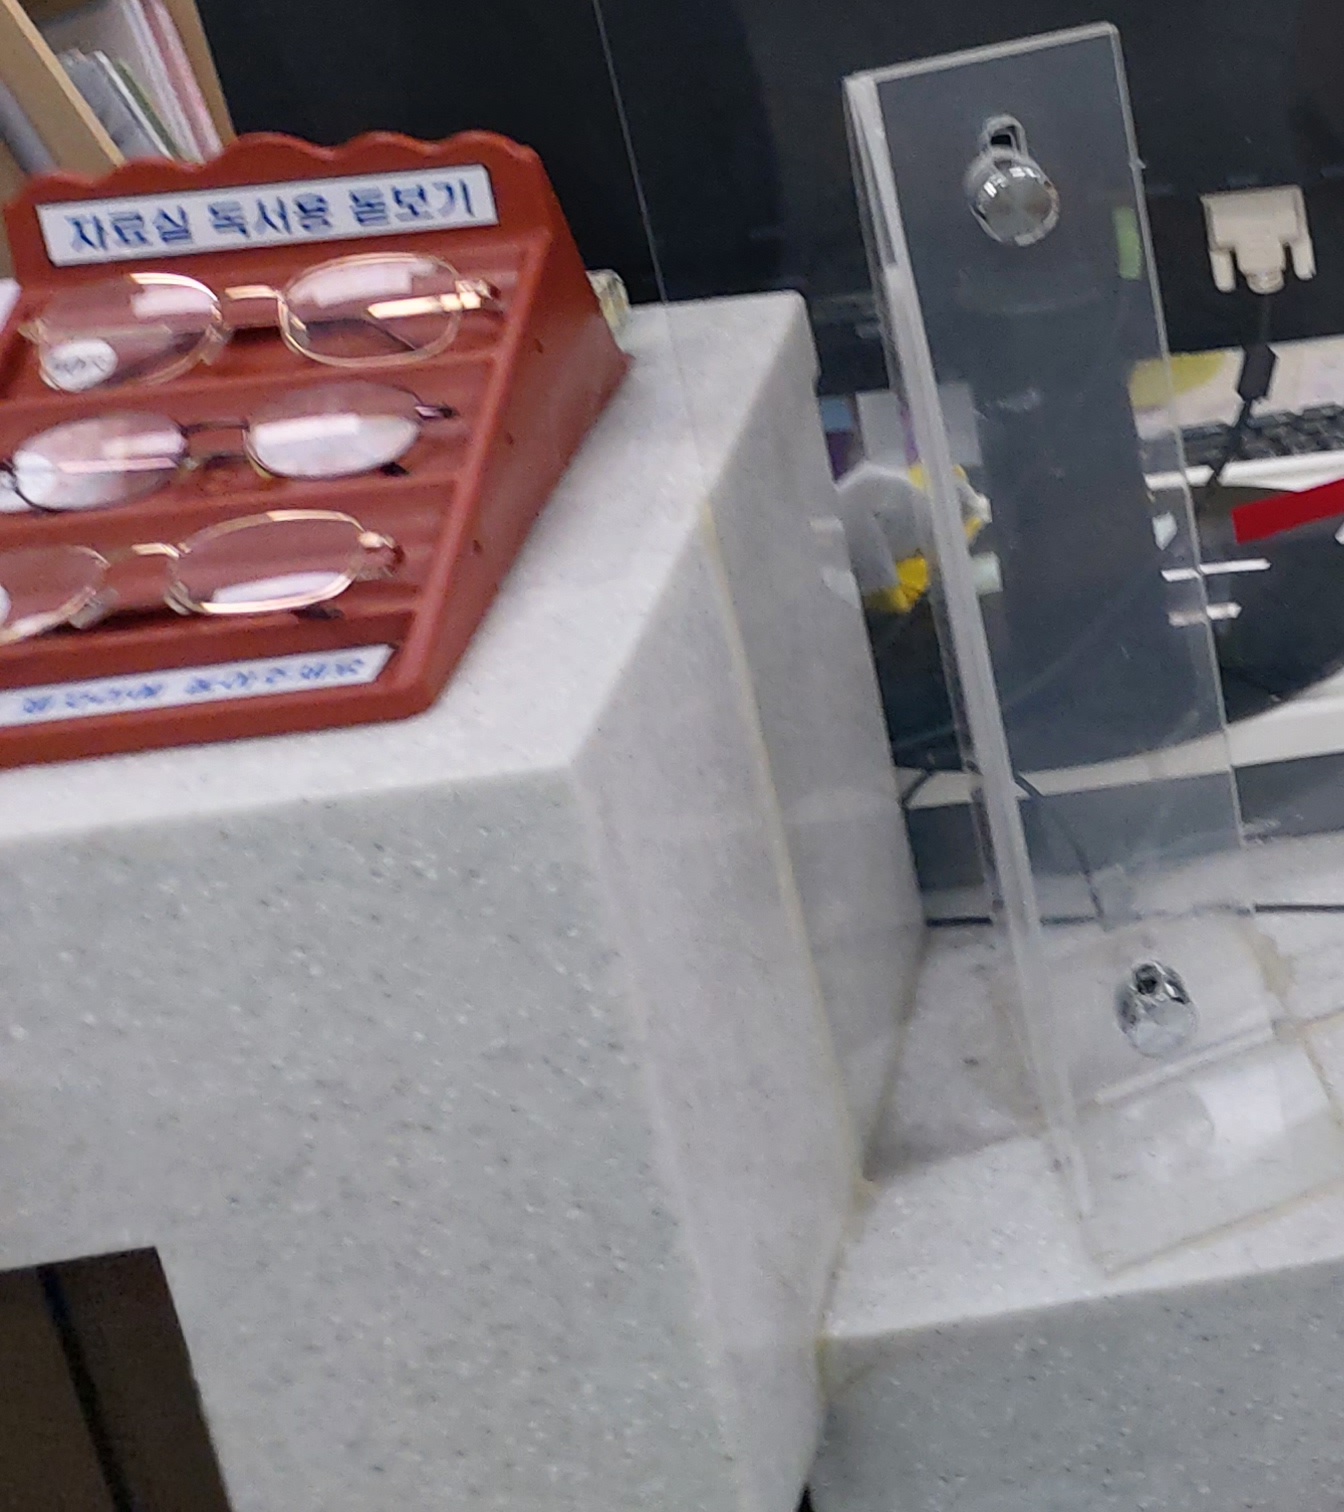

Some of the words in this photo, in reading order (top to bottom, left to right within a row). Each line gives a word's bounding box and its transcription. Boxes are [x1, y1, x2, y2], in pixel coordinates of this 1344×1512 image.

[64, 203, 194, 253] 자료실
[207, 191, 332, 239] 독서용
[348, 178, 476, 228] 돋보기
